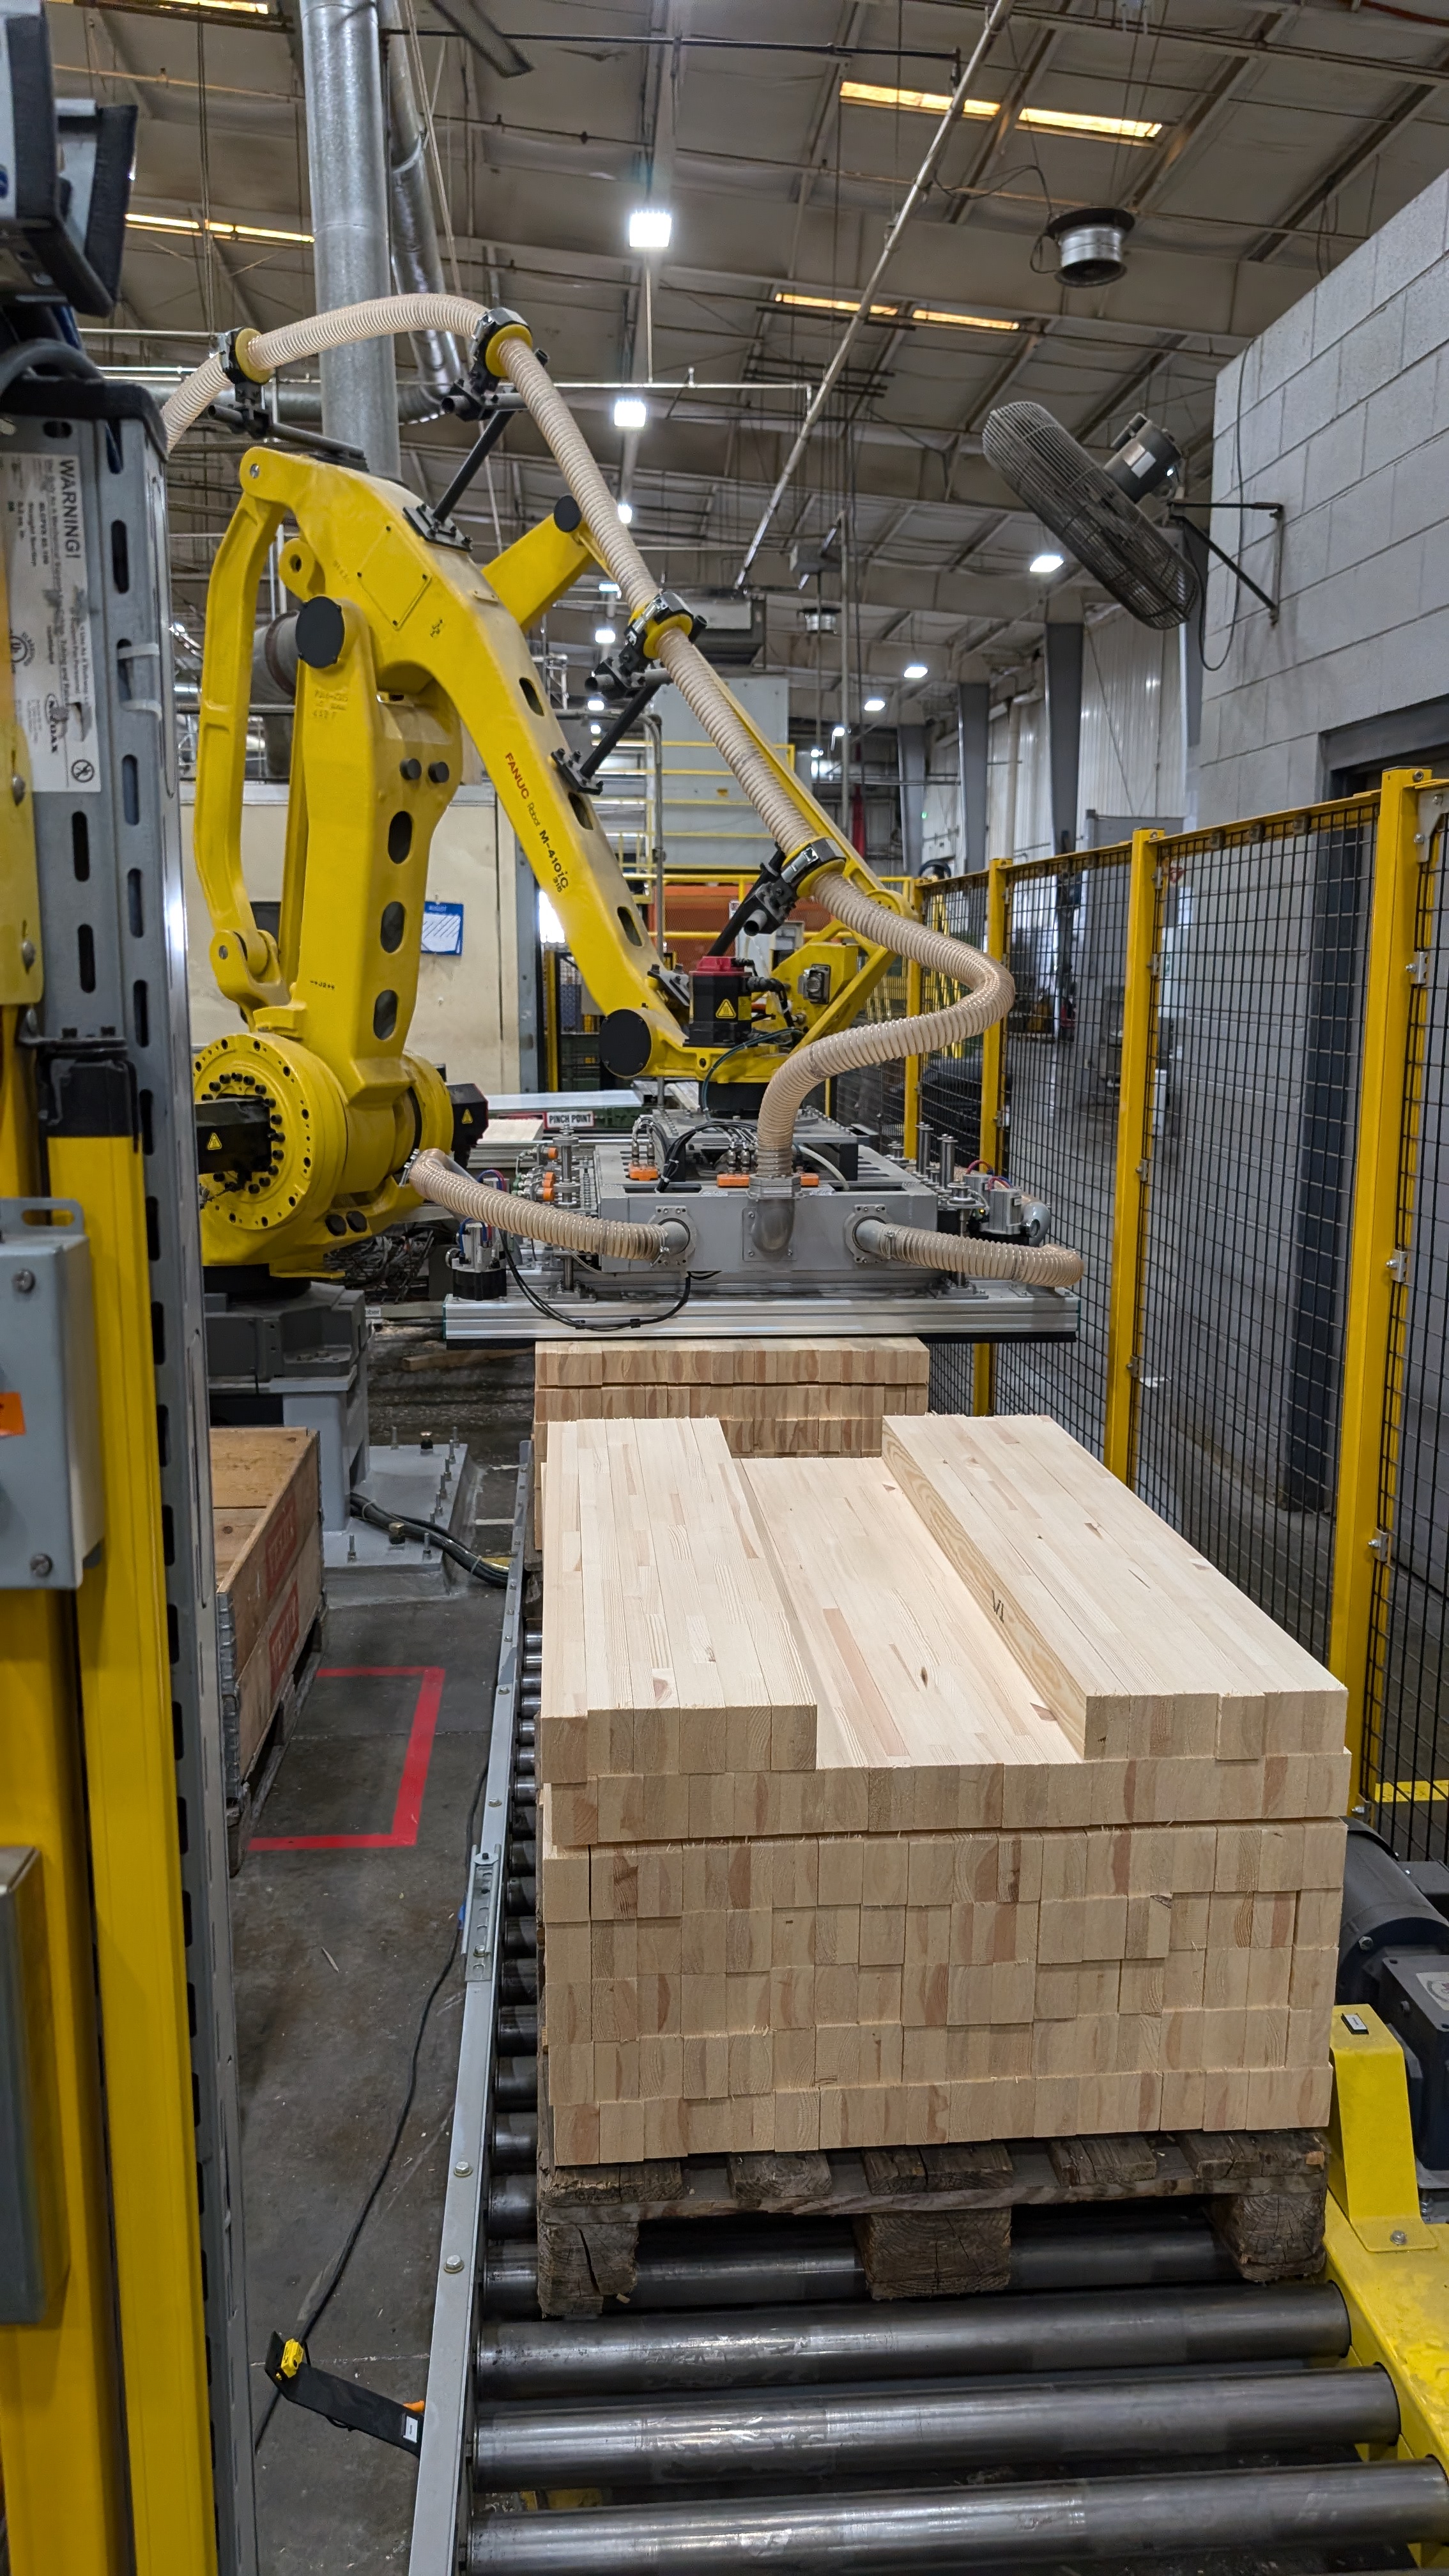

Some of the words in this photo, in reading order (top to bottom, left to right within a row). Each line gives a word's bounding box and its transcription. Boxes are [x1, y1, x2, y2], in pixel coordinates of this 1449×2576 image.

[59, 459, 80, 558] WARNING!
[505, 752, 530, 800] FANUC
[527, 802, 540, 827] Robot
[549, 1114, 570, 1124] PINCH
[571, 1114, 591, 1123] POINT
